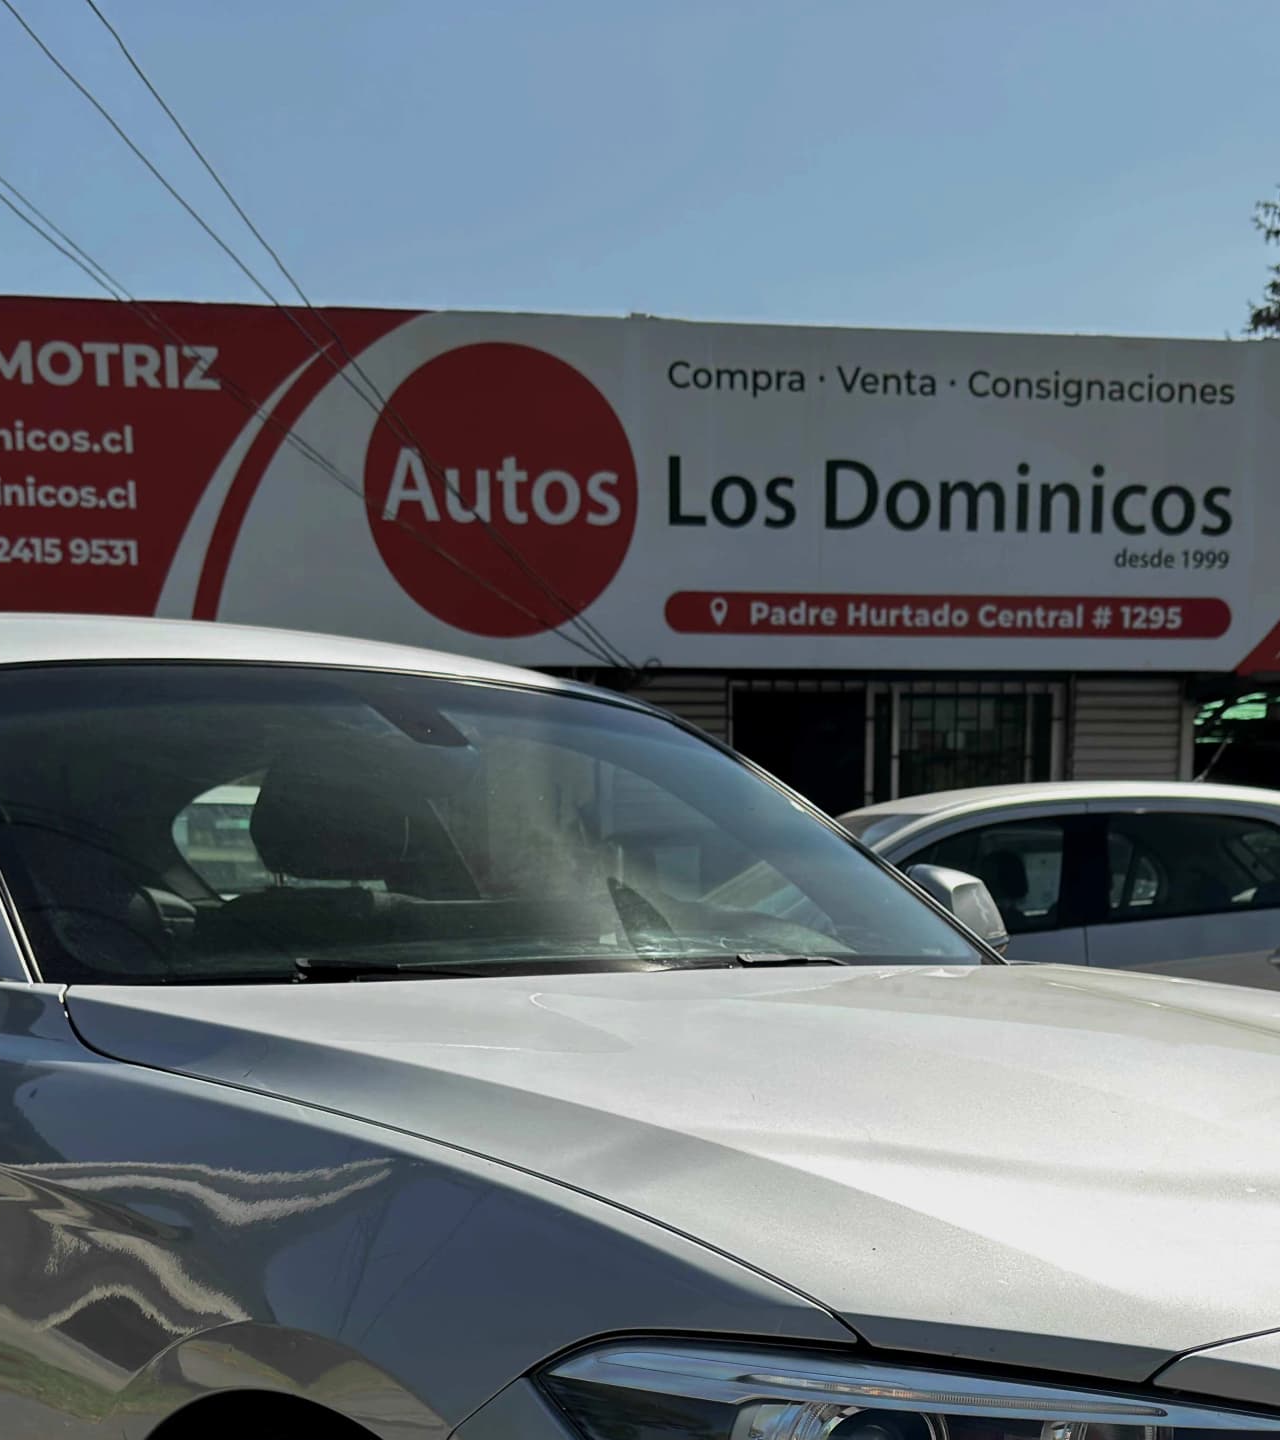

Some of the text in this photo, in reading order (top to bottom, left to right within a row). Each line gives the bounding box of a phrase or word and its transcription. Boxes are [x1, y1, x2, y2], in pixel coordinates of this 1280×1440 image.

[668, 361, 805, 398] Compra
[837, 366, 936, 396] Venta
[968, 370, 1234, 407] Consignaciones
[383, 448, 620, 525] Autos
[669, 456, 1232, 536] Los Dominicos
[72, 538, 137, 566] 9531
[1115, 548, 1229, 569] desde 1999
[751, 601, 837, 625] Padre
[848, 603, 968, 627] Hurtado
[978, 604, 1083, 628] Central
[1121, 606, 1182, 629] 1295
